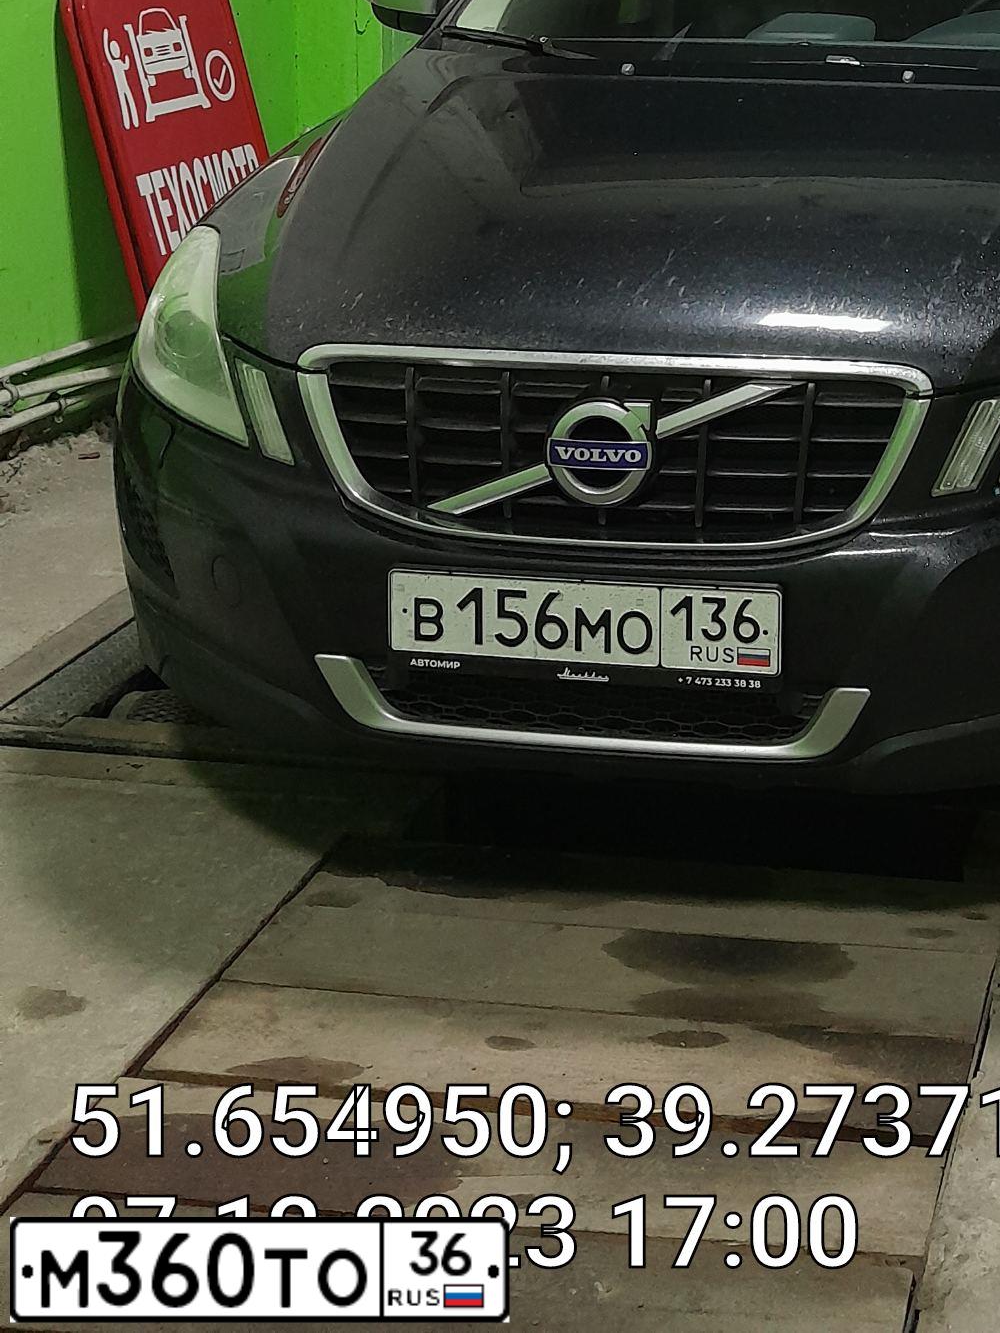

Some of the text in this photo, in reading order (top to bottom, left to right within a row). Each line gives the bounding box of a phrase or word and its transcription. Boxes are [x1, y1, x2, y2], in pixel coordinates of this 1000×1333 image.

[554, 446, 642, 463] VOLVO
[413, 586, 761, 655] В156МО 136
[410, 657, 461, 669] АВТОМИР
[690, 645, 735, 664] RUS
[695, 677, 713, 686] 473
[715, 678, 732, 687] 233
[734, 679, 747, 688] 38
[748, 680, 761, 688] 38
